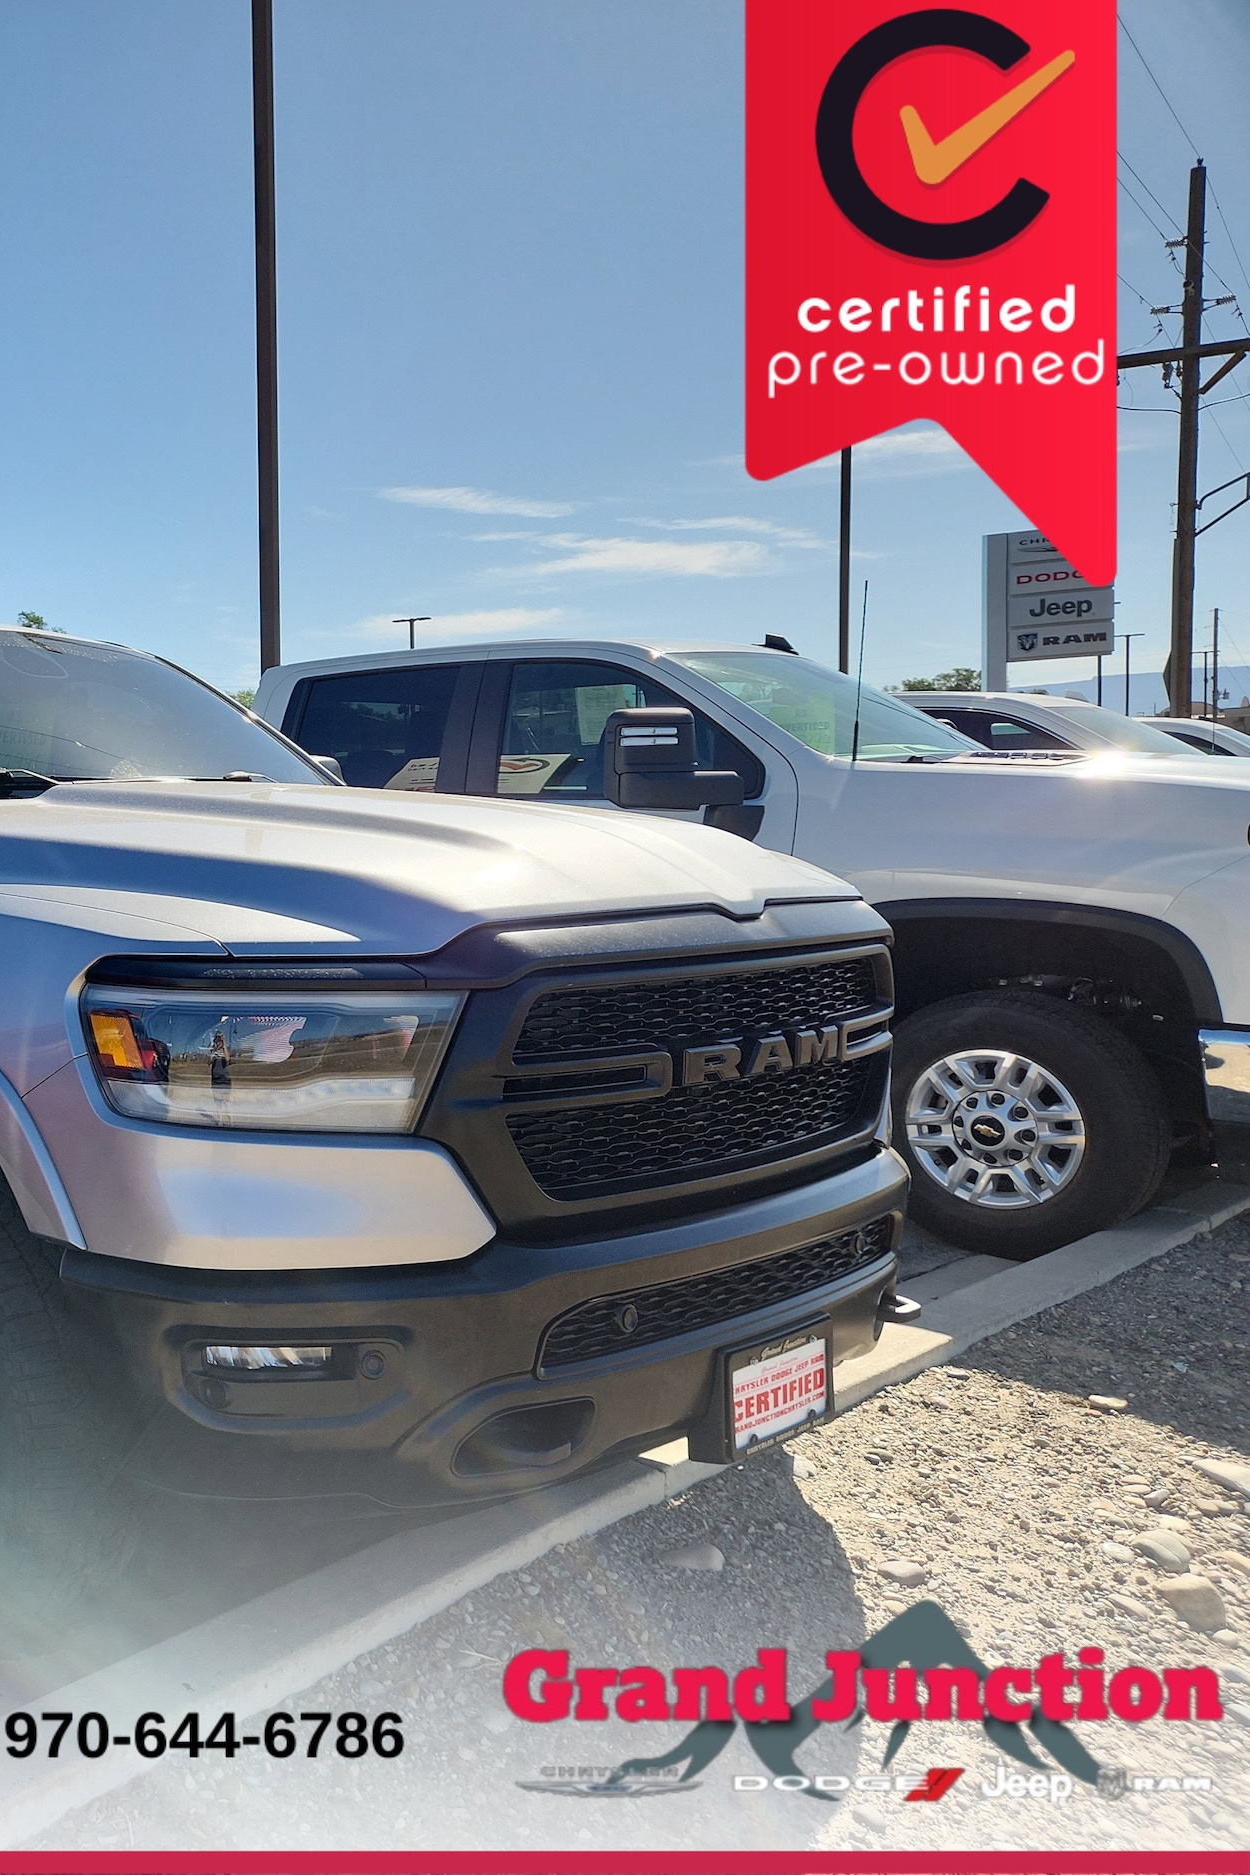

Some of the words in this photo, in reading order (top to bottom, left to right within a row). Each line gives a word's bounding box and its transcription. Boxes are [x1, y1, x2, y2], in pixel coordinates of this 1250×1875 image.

[1016, 570, 1084, 584] DODG
[1029, 599, 1093, 617] Jeep
[1043, 633, 1107, 646] RAM
[684, 1025, 838, 1086] RAM
[734, 1376, 768, 1395] HRYSLER
[772, 1368, 793, 1382] DODGE
[795, 1361, 809, 1372] JEEP
[734, 1368, 824, 1422] CERTIFIED
